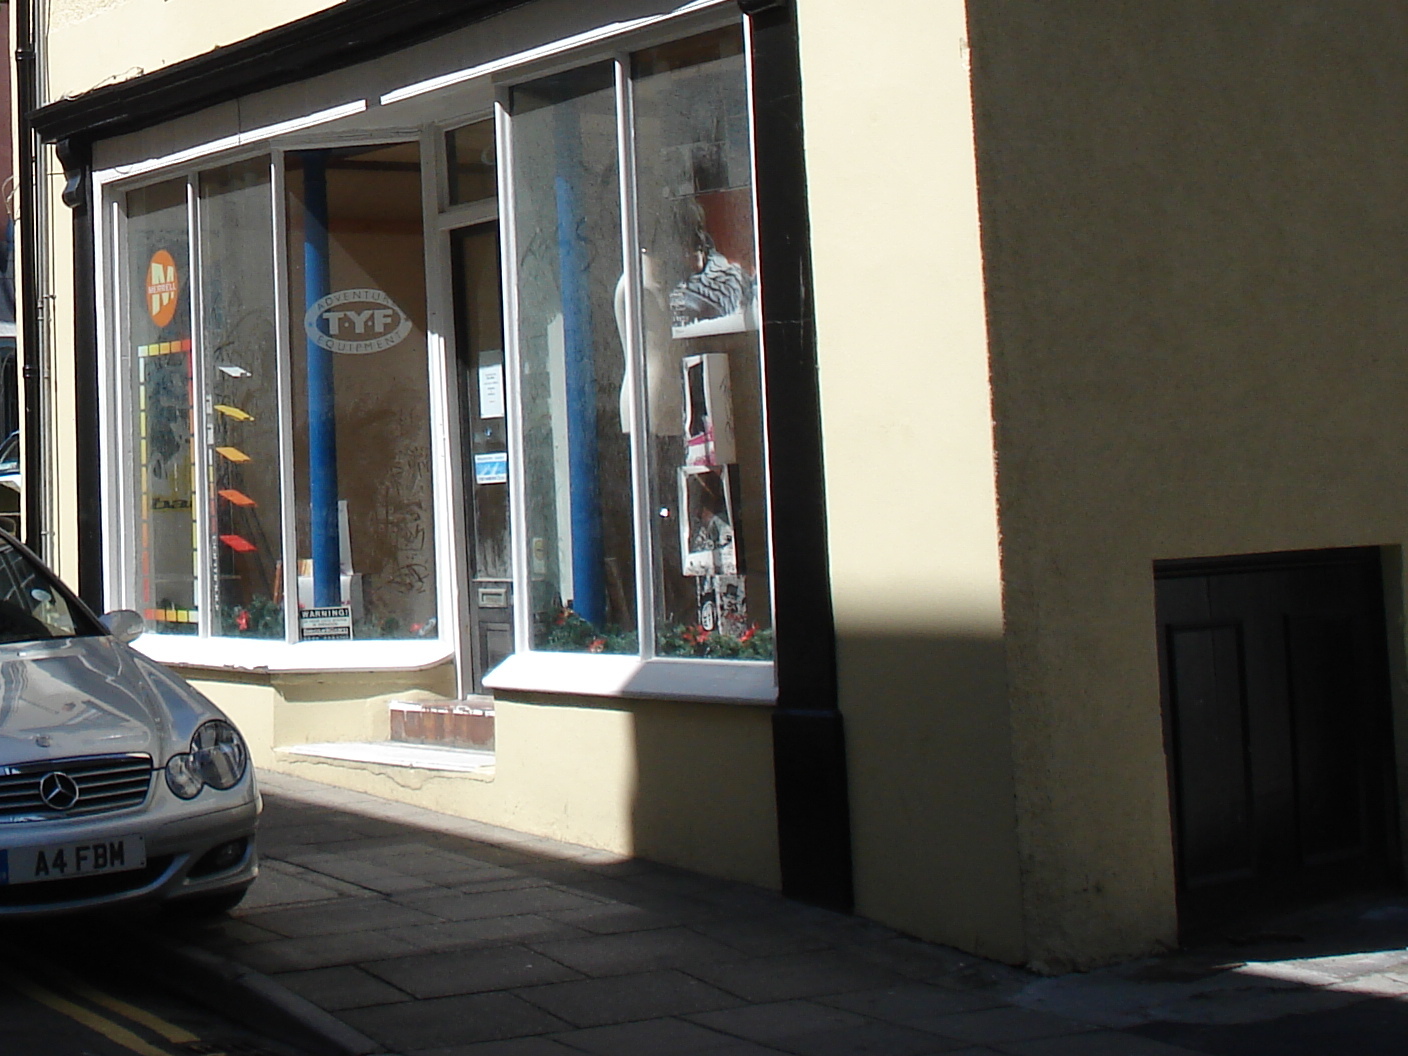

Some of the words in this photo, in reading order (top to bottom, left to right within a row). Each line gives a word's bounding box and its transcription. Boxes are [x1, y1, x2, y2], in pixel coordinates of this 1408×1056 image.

[148, 282, 177, 295] MERRELL
[317, 290, 394, 311] ADVENTUR
[317, 332, 402, 352] EQUIPMENT
[301, 609, 349, 618] WARNING!
[35, 848, 68, 876] A4
[75, 841, 125, 872] FBM
